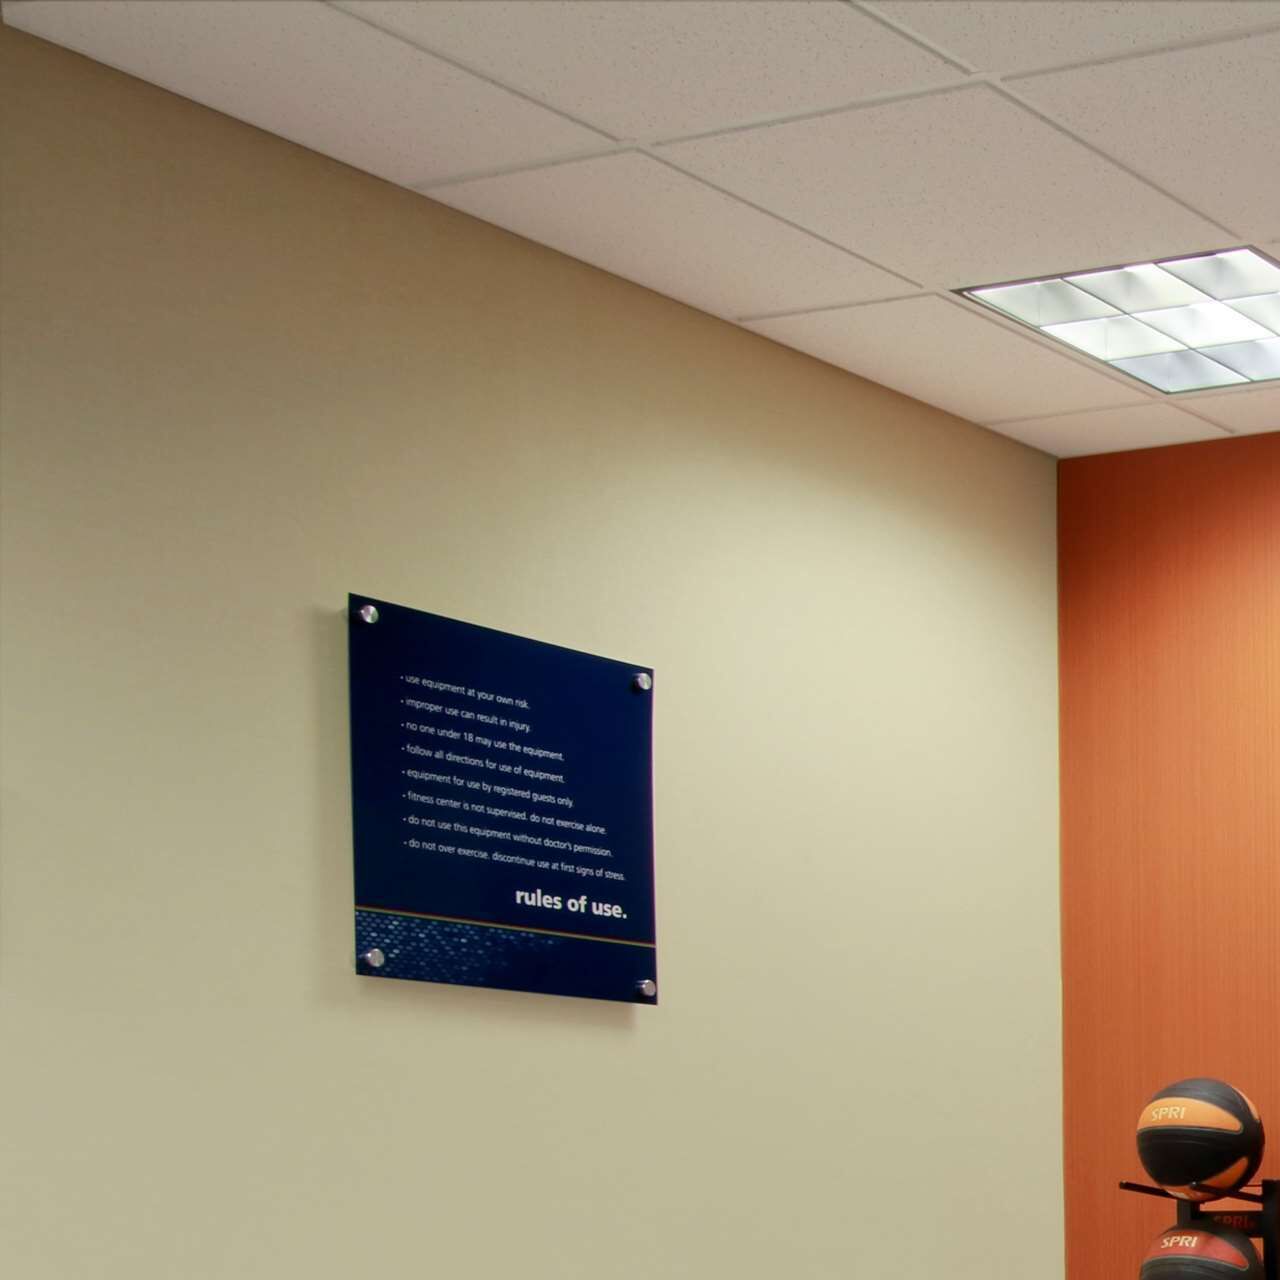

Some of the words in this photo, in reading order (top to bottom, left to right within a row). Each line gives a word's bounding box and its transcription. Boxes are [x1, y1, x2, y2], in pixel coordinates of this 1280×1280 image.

[406, 675, 419, 685] use
[422, 679, 465, 695] equipment
[467, 688, 476, 697] at
[477, 691, 495, 701] your
[496, 695, 514, 705] own
[406, 699, 442, 712] improper
[445, 708, 459, 717] use
[461, 711, 475, 720] can
[477, 713, 499, 725] result
[500, 718, 508, 726] in
[406, 722, 418, 731] no
[420, 725, 436, 735] one
[437, 728, 461, 740] under
[464, 732, 474, 742] 18
[475, 736, 492, 748] may
[493, 740, 507, 750] use
[509, 741, 521, 752] the
[522, 746, 565, 761] equipment.
[406, 744, 433, 757] follow
[434, 750, 444, 759] all
[446, 752, 484, 767] directions
[485, 758, 497, 769] for
[499, 764, 512, 773] use
[514, 765, 522, 775] of
[523, 769, 565, 784] equipment.
[407, 769, 451, 784] equipment
[453, 776, 465, 786] for
[466, 780, 481, 789] use
[482, 782, 492, 793] by
[493, 785, 531, 799] registered
[532, 792, 556, 803] guests
[408, 790, 434, 804] fitness
[436, 797, 462, 809] center
[463, 803, 470, 811] is
[471, 803, 485, 813] not
[486, 806, 528, 821] supervised.
[530, 813, 541, 823] do
[542, 816, 555, 825] not
[556, 819, 584, 831] exercise
[408, 815, 420, 825] do
[421, 818, 436, 828] not
[437, 821, 452, 831] use
[453, 823, 468, 833] this
[469, 826, 512, 841] equipment
[512, 833, 542, 846] without
[543, 838, 572, 851] doctor's
[573, 844, 614, 858] permission.
[408, 839, 420, 849] do
[421, 842, 437, 852] not
[438, 845, 456, 854] over
[457, 848, 490, 860] exercise.
[492, 852, 536, 868] discontinue
[536, 861, 550, 869] use
[551, 862, 559, 870] at
[561, 862, 575, 872] first
[576, 866, 594, 877] signs
[595, 868, 603, 877] of
[516, 888, 563, 910] rules
[567, 896, 588, 913] of
[592, 901, 628, 919] use.
[1151, 1106, 1186, 1121] SPRI
[1160, 1235, 1199, 1249] SPRI
